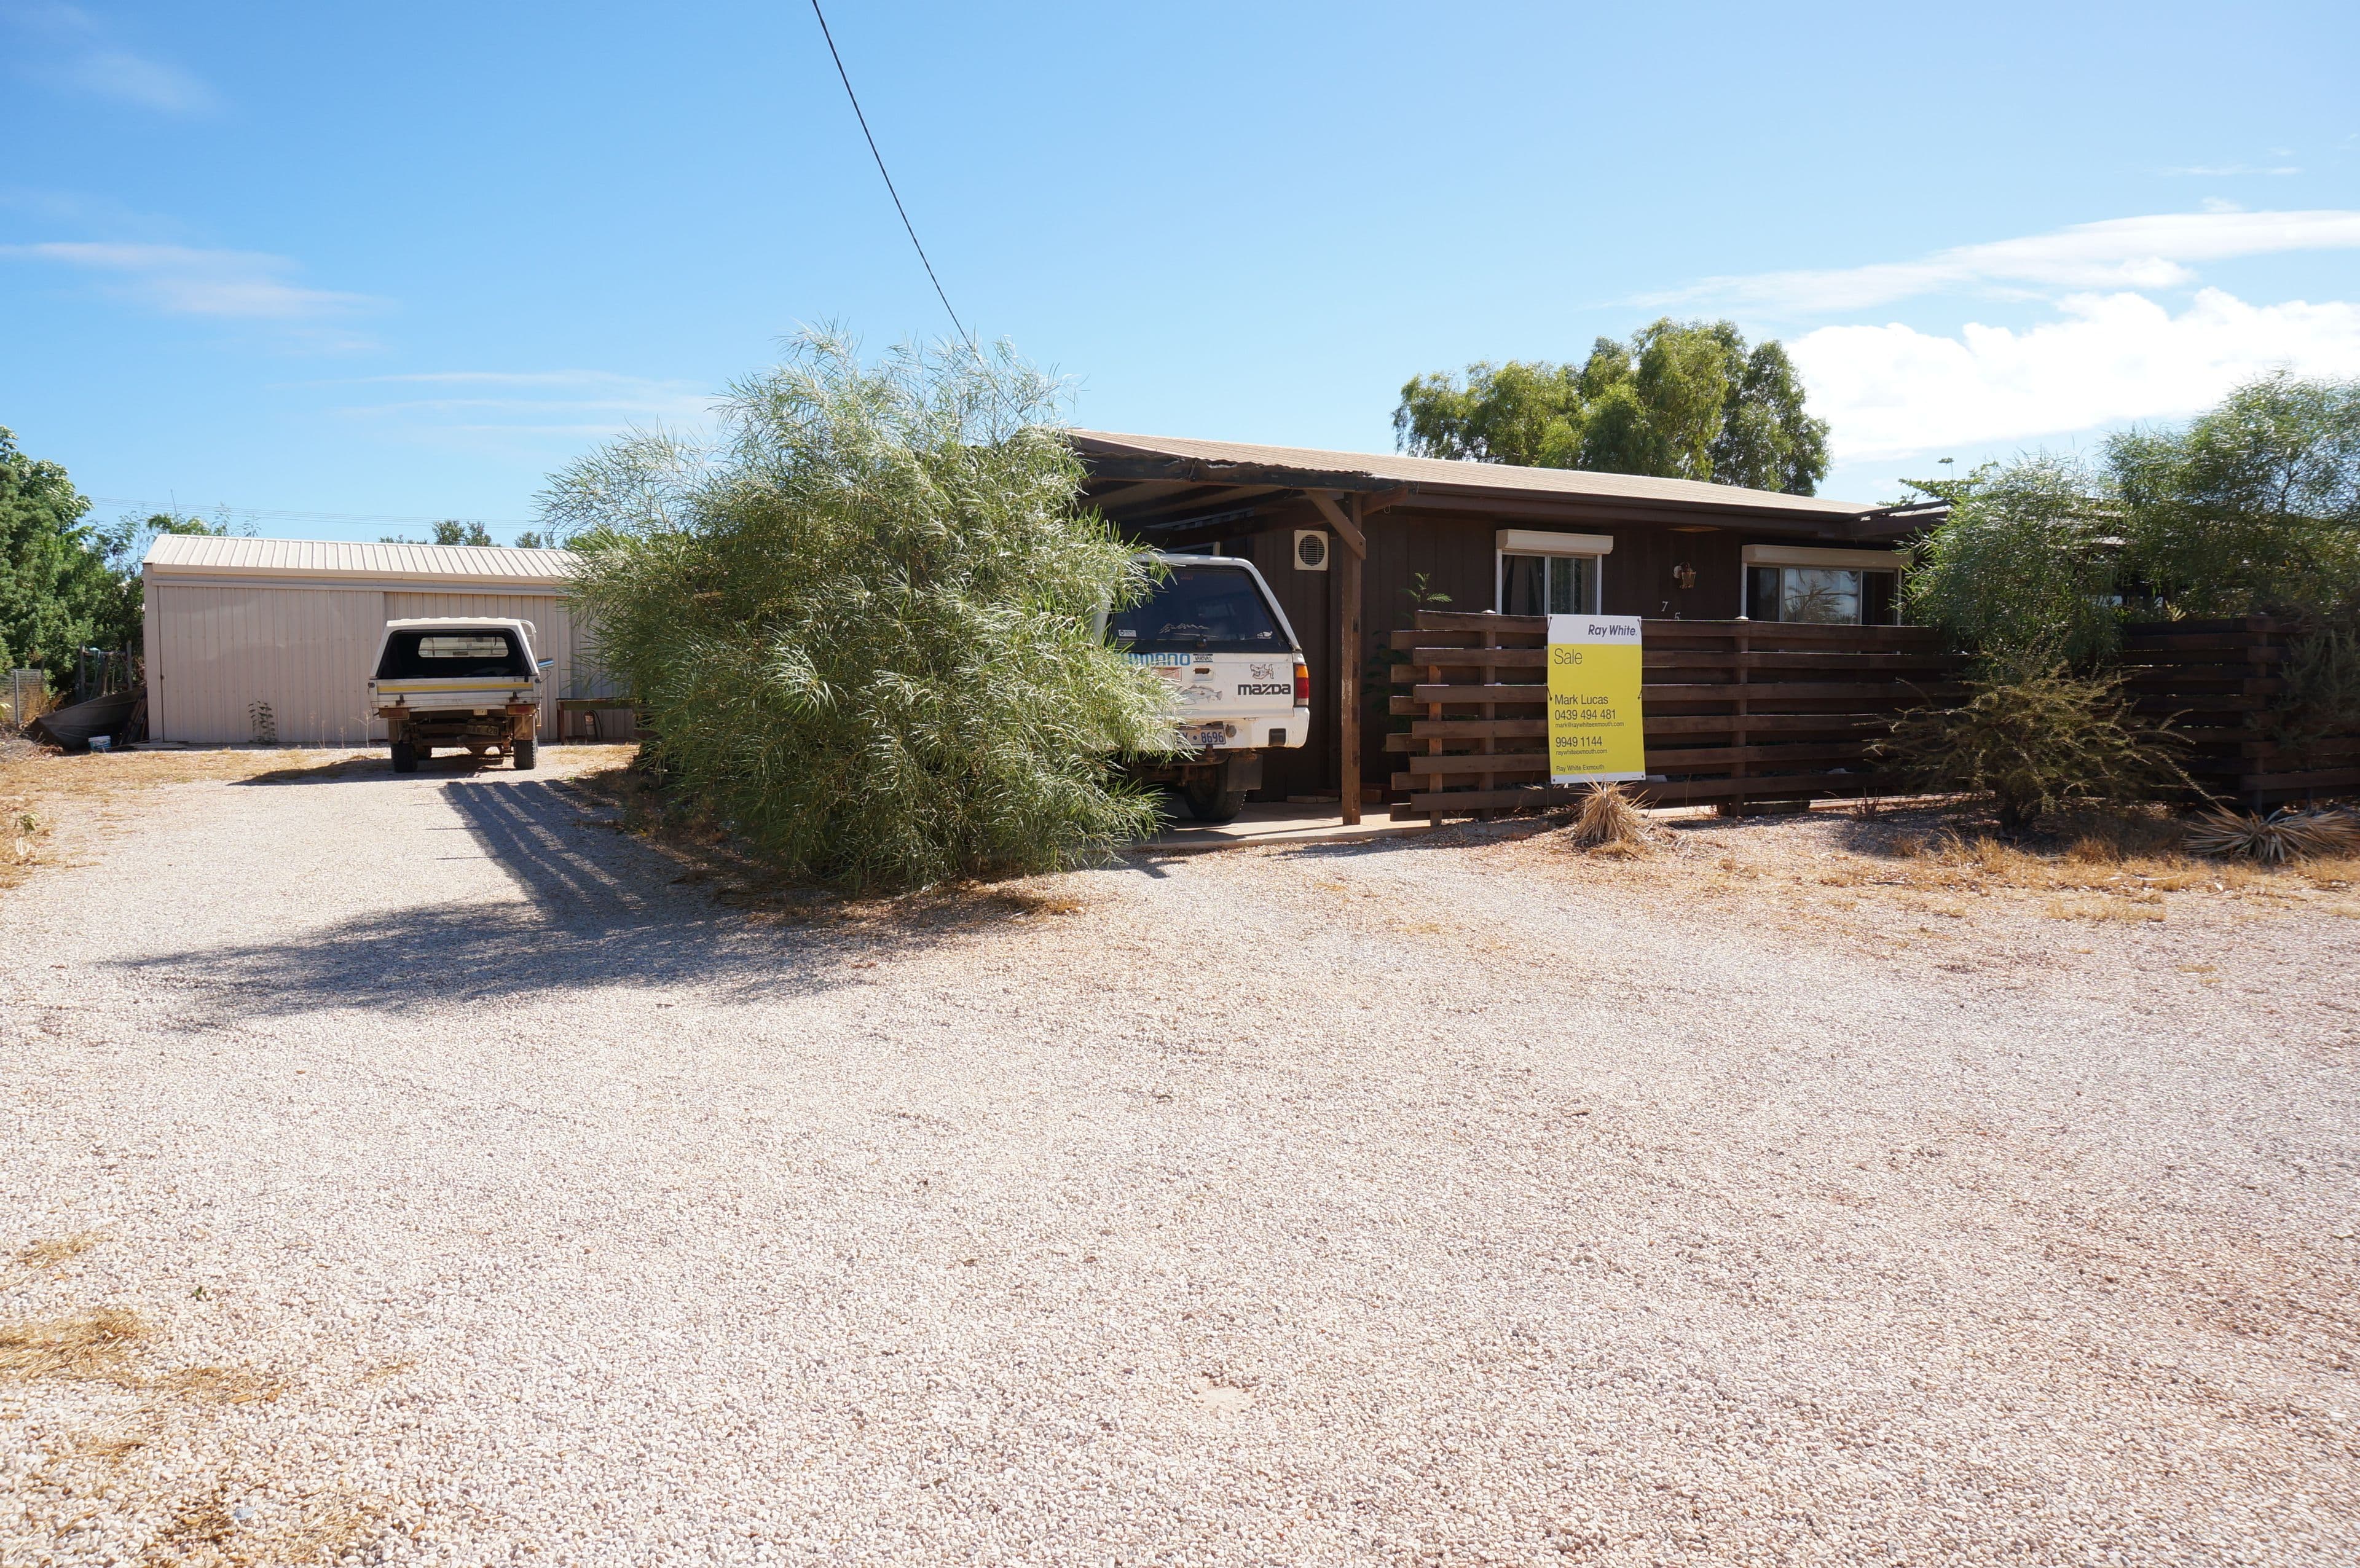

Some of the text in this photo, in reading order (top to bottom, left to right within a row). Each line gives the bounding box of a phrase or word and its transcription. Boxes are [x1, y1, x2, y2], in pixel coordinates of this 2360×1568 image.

[1661, 600, 1669, 612] 7
[1587, 624, 1636, 638] Ray White
[1554, 648, 1583, 665] Sale
[1554, 694, 1608, 705] Mark Lucas
[1554, 708, 1616, 720] 0439 494 481
[1201, 731, 1224, 743] 8696
[1556, 735, 1603, 748] 9949 1144
